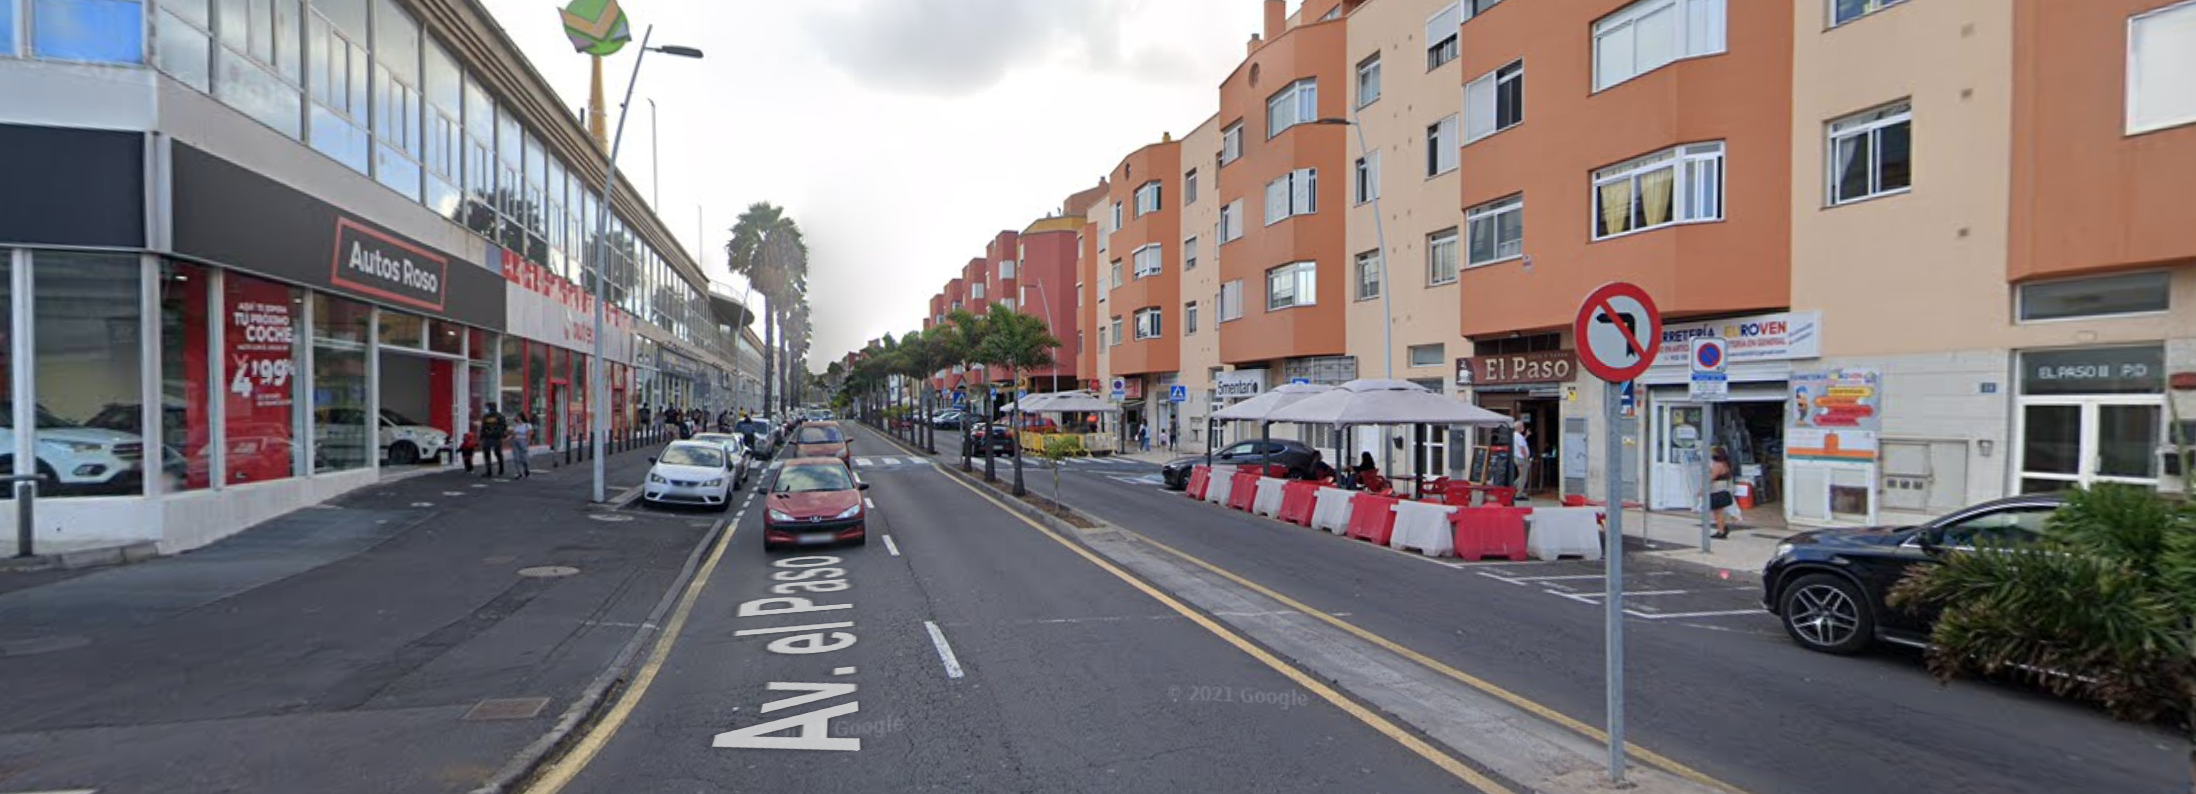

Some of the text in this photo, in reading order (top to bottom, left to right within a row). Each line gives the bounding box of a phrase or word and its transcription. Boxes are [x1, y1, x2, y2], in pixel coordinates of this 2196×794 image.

[349, 240, 438, 293] Autos Roso
[233, 312, 249, 327] TU
[245, 325, 294, 343] COCHE
[1724, 322, 1787, 337] EUROVEN
[1485, 356, 1570, 380] El Paso
[2038, 366, 2057, 379] EL
[2058, 365, 2096, 379] PASO
